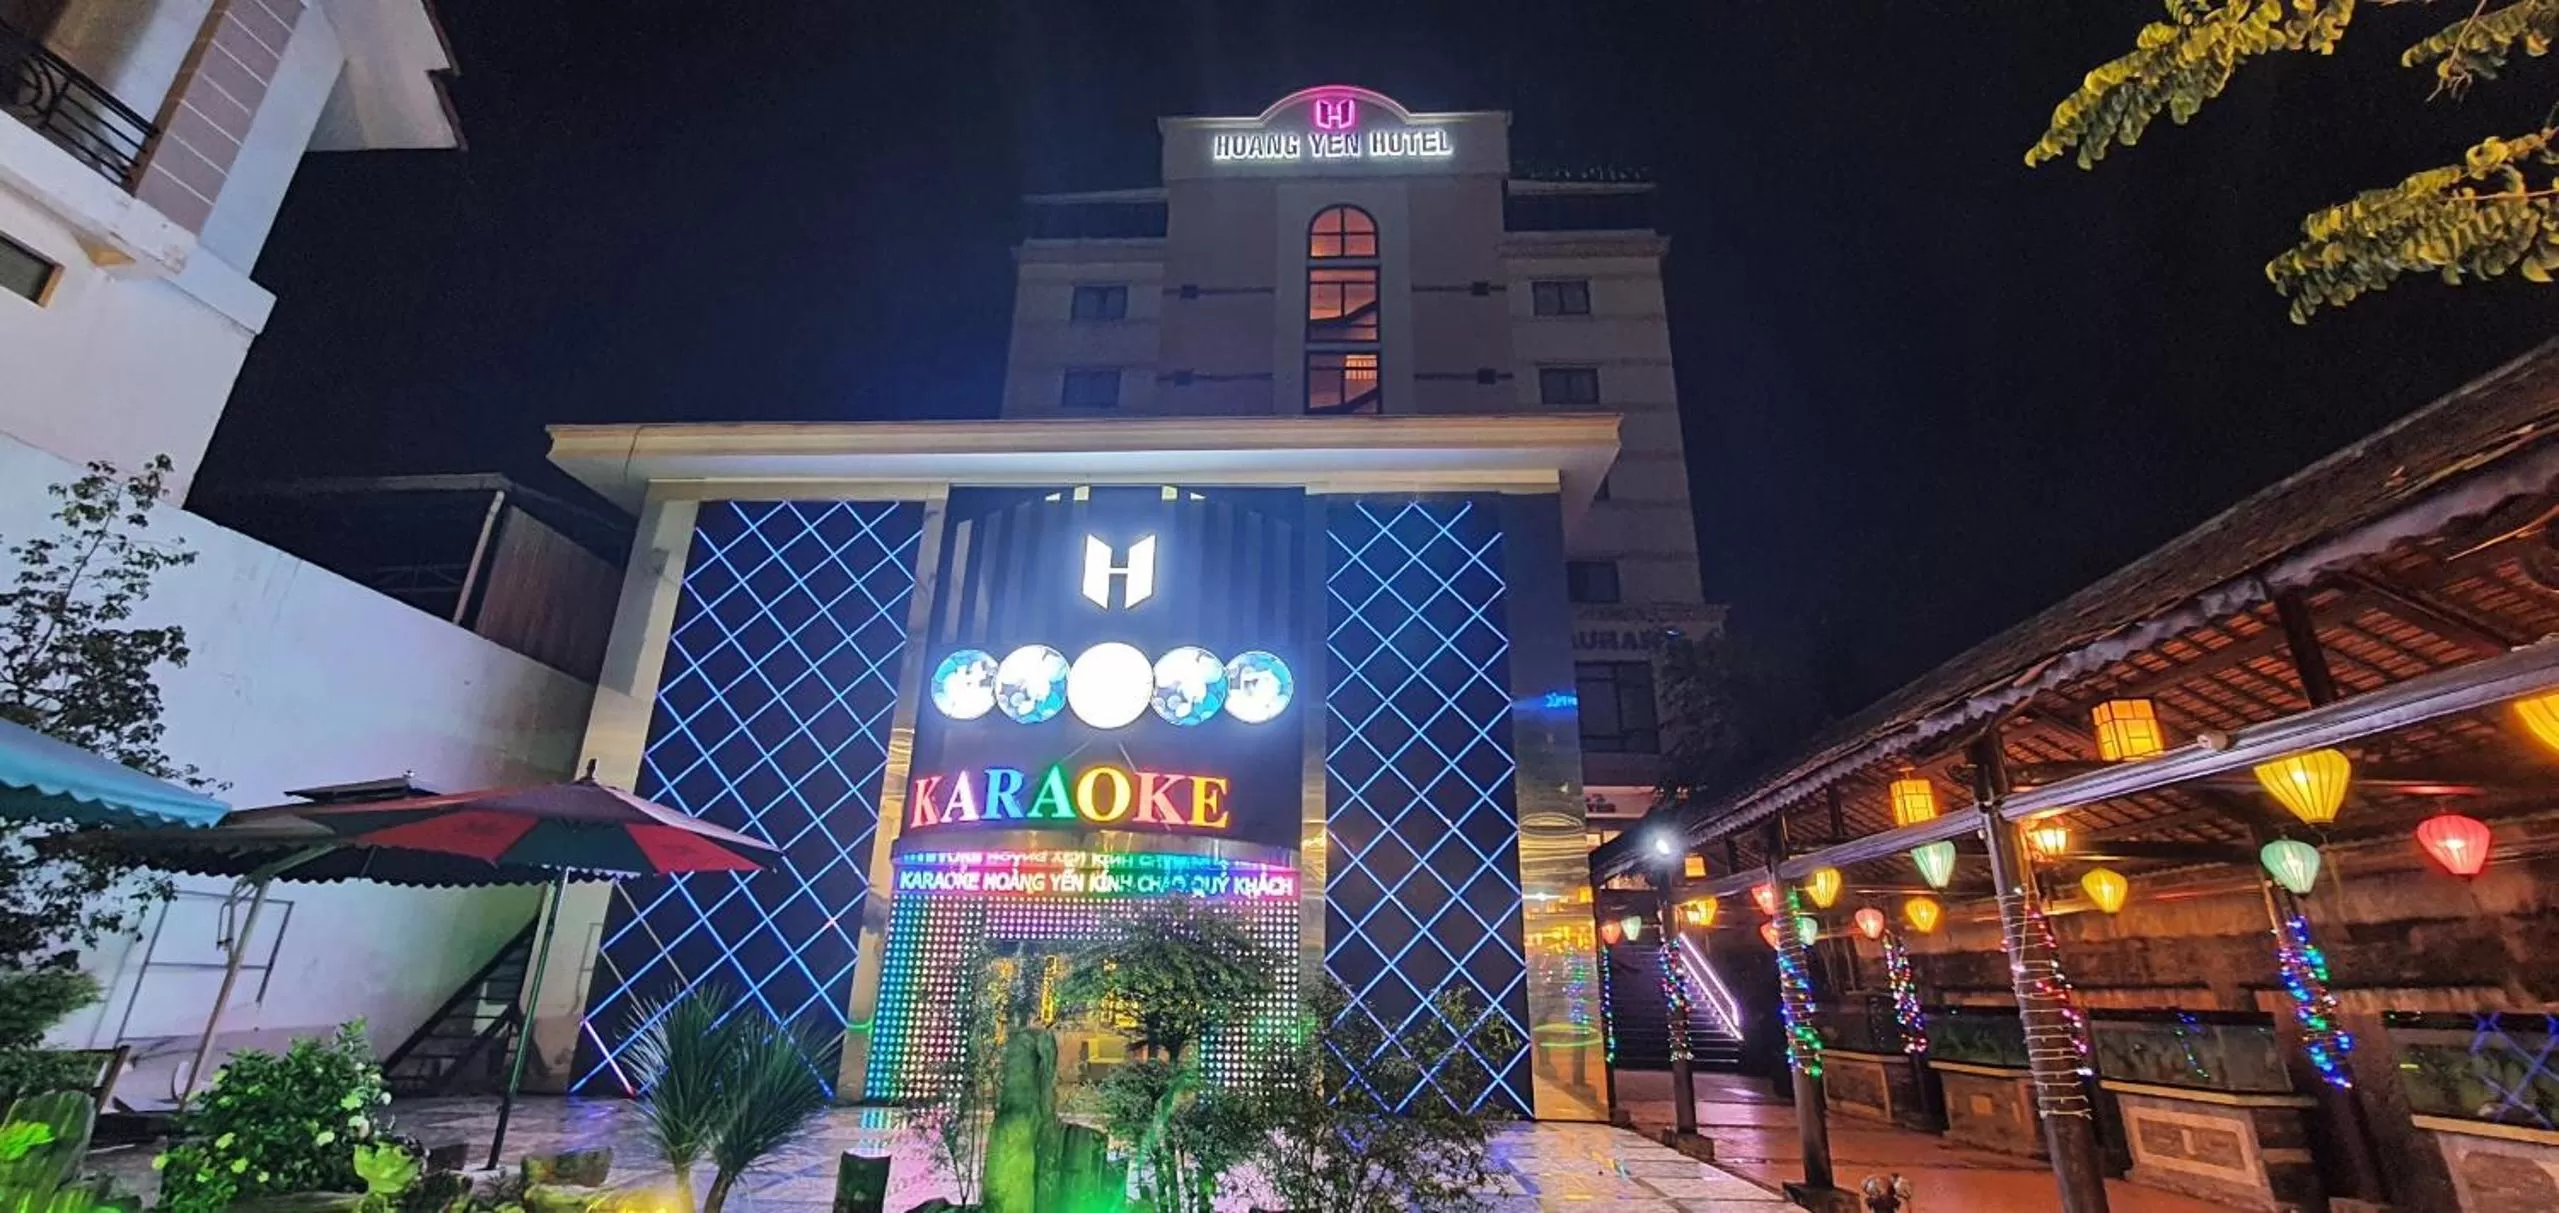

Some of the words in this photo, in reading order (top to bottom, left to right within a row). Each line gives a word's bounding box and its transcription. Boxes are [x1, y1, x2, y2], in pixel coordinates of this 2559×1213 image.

[1214, 135, 1300, 159] HOANG
[1308, 133, 1361, 157] YEN
[1369, 130, 1453, 156] HOTEL
[1082, 533, 1157, 610] H
[910, 765, 1230, 829] KARAOKE
[900, 871, 981, 890] KARAOKE
